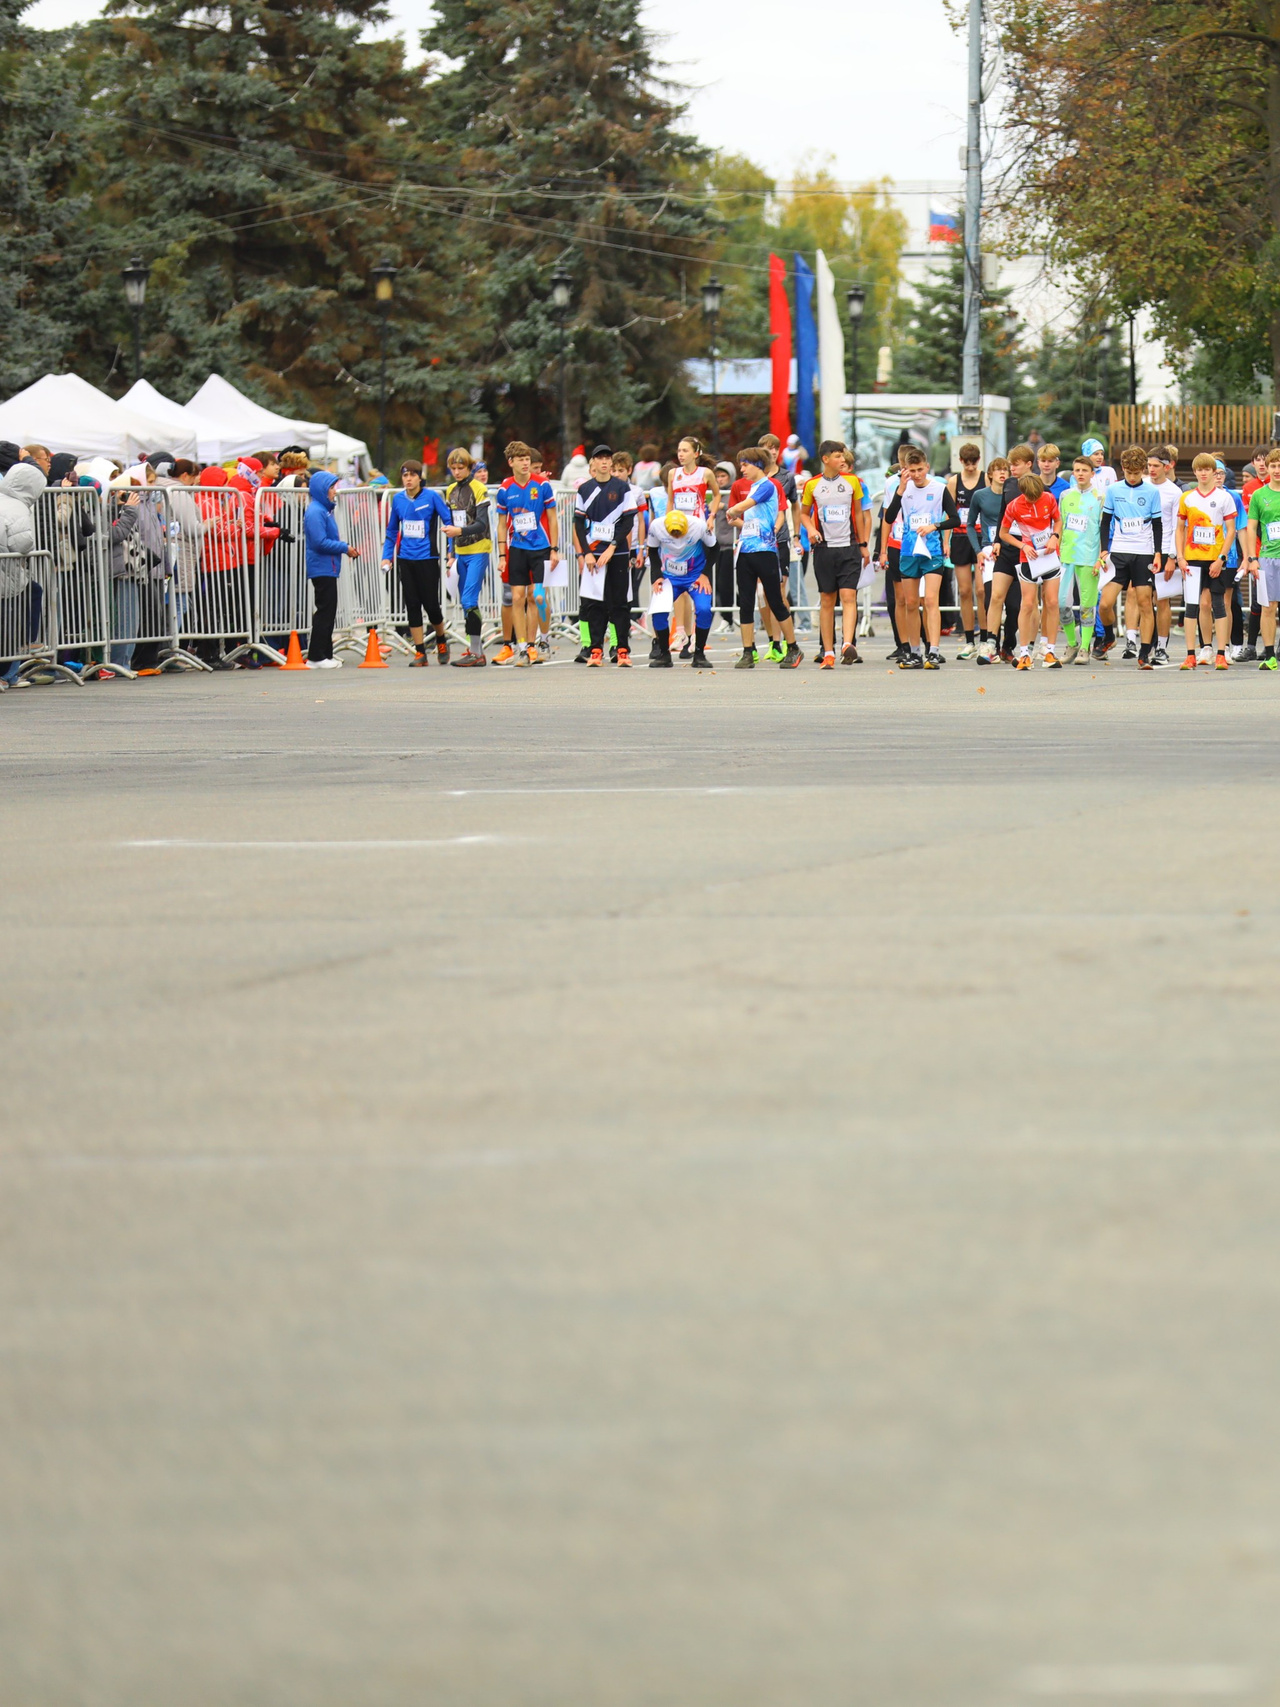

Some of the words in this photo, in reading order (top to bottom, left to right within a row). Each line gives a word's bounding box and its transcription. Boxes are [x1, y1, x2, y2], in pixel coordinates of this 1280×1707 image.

[516, 517, 532, 525] 302.1
[1068, 517, 1084, 525] 329.1
[1123, 520, 1140, 528] 310.1
[595, 526, 611, 534] 303.1
